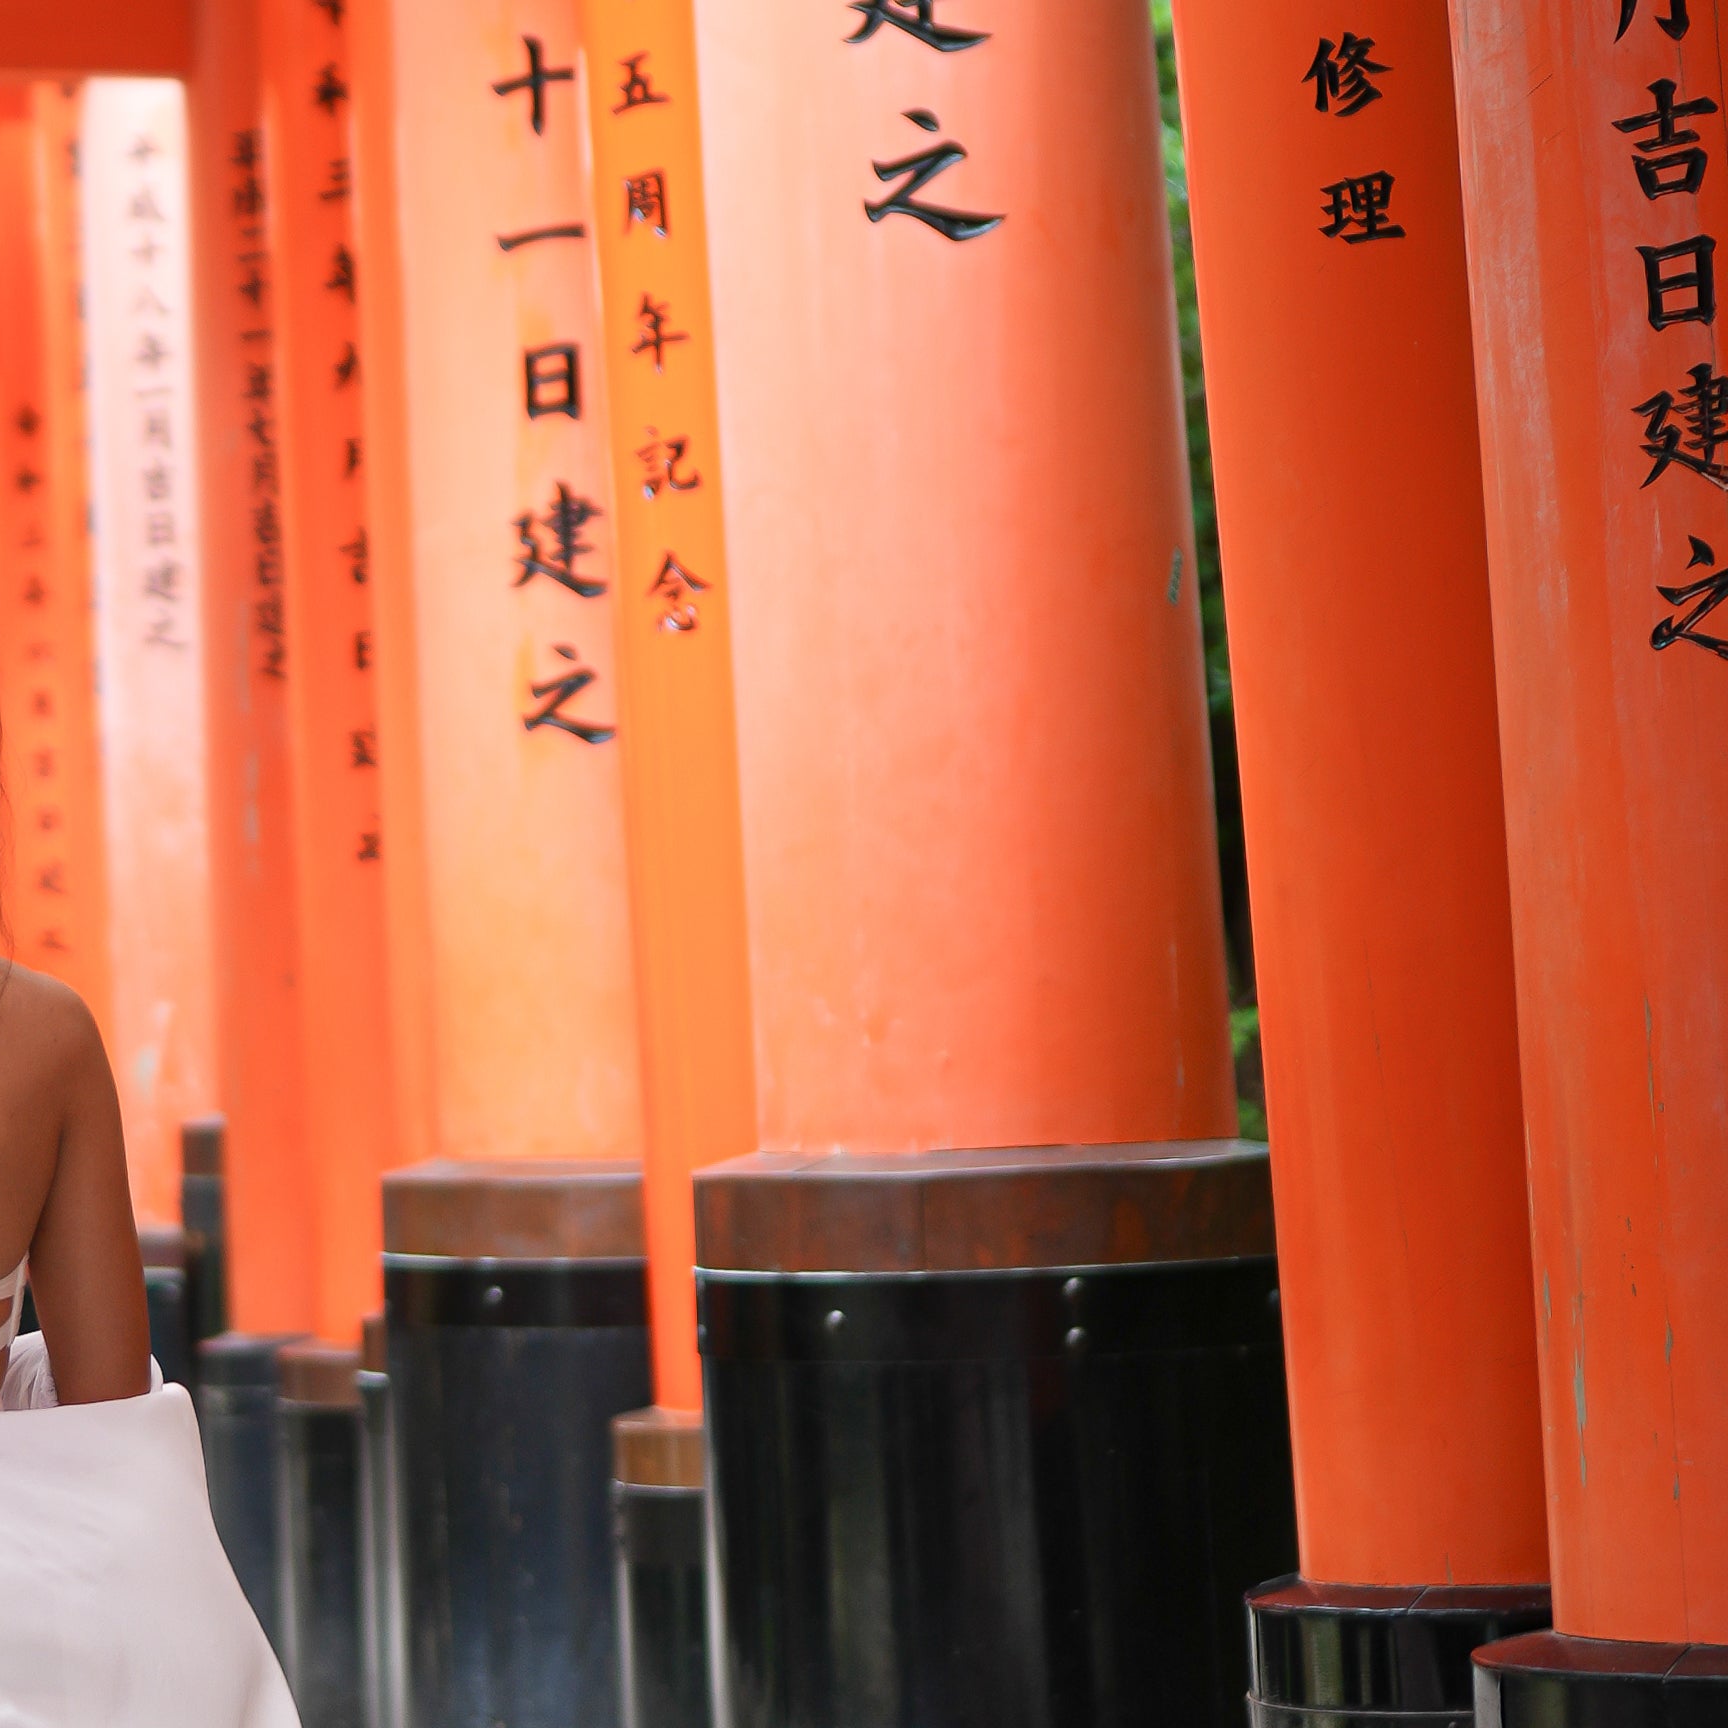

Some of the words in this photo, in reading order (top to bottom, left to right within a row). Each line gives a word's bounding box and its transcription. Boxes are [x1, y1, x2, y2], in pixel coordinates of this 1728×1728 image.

[490, 34, 616, 746] 十一日建之
[610, 50, 712, 636] 五周年記念
[1301, 31, 1407, 245] 修理
